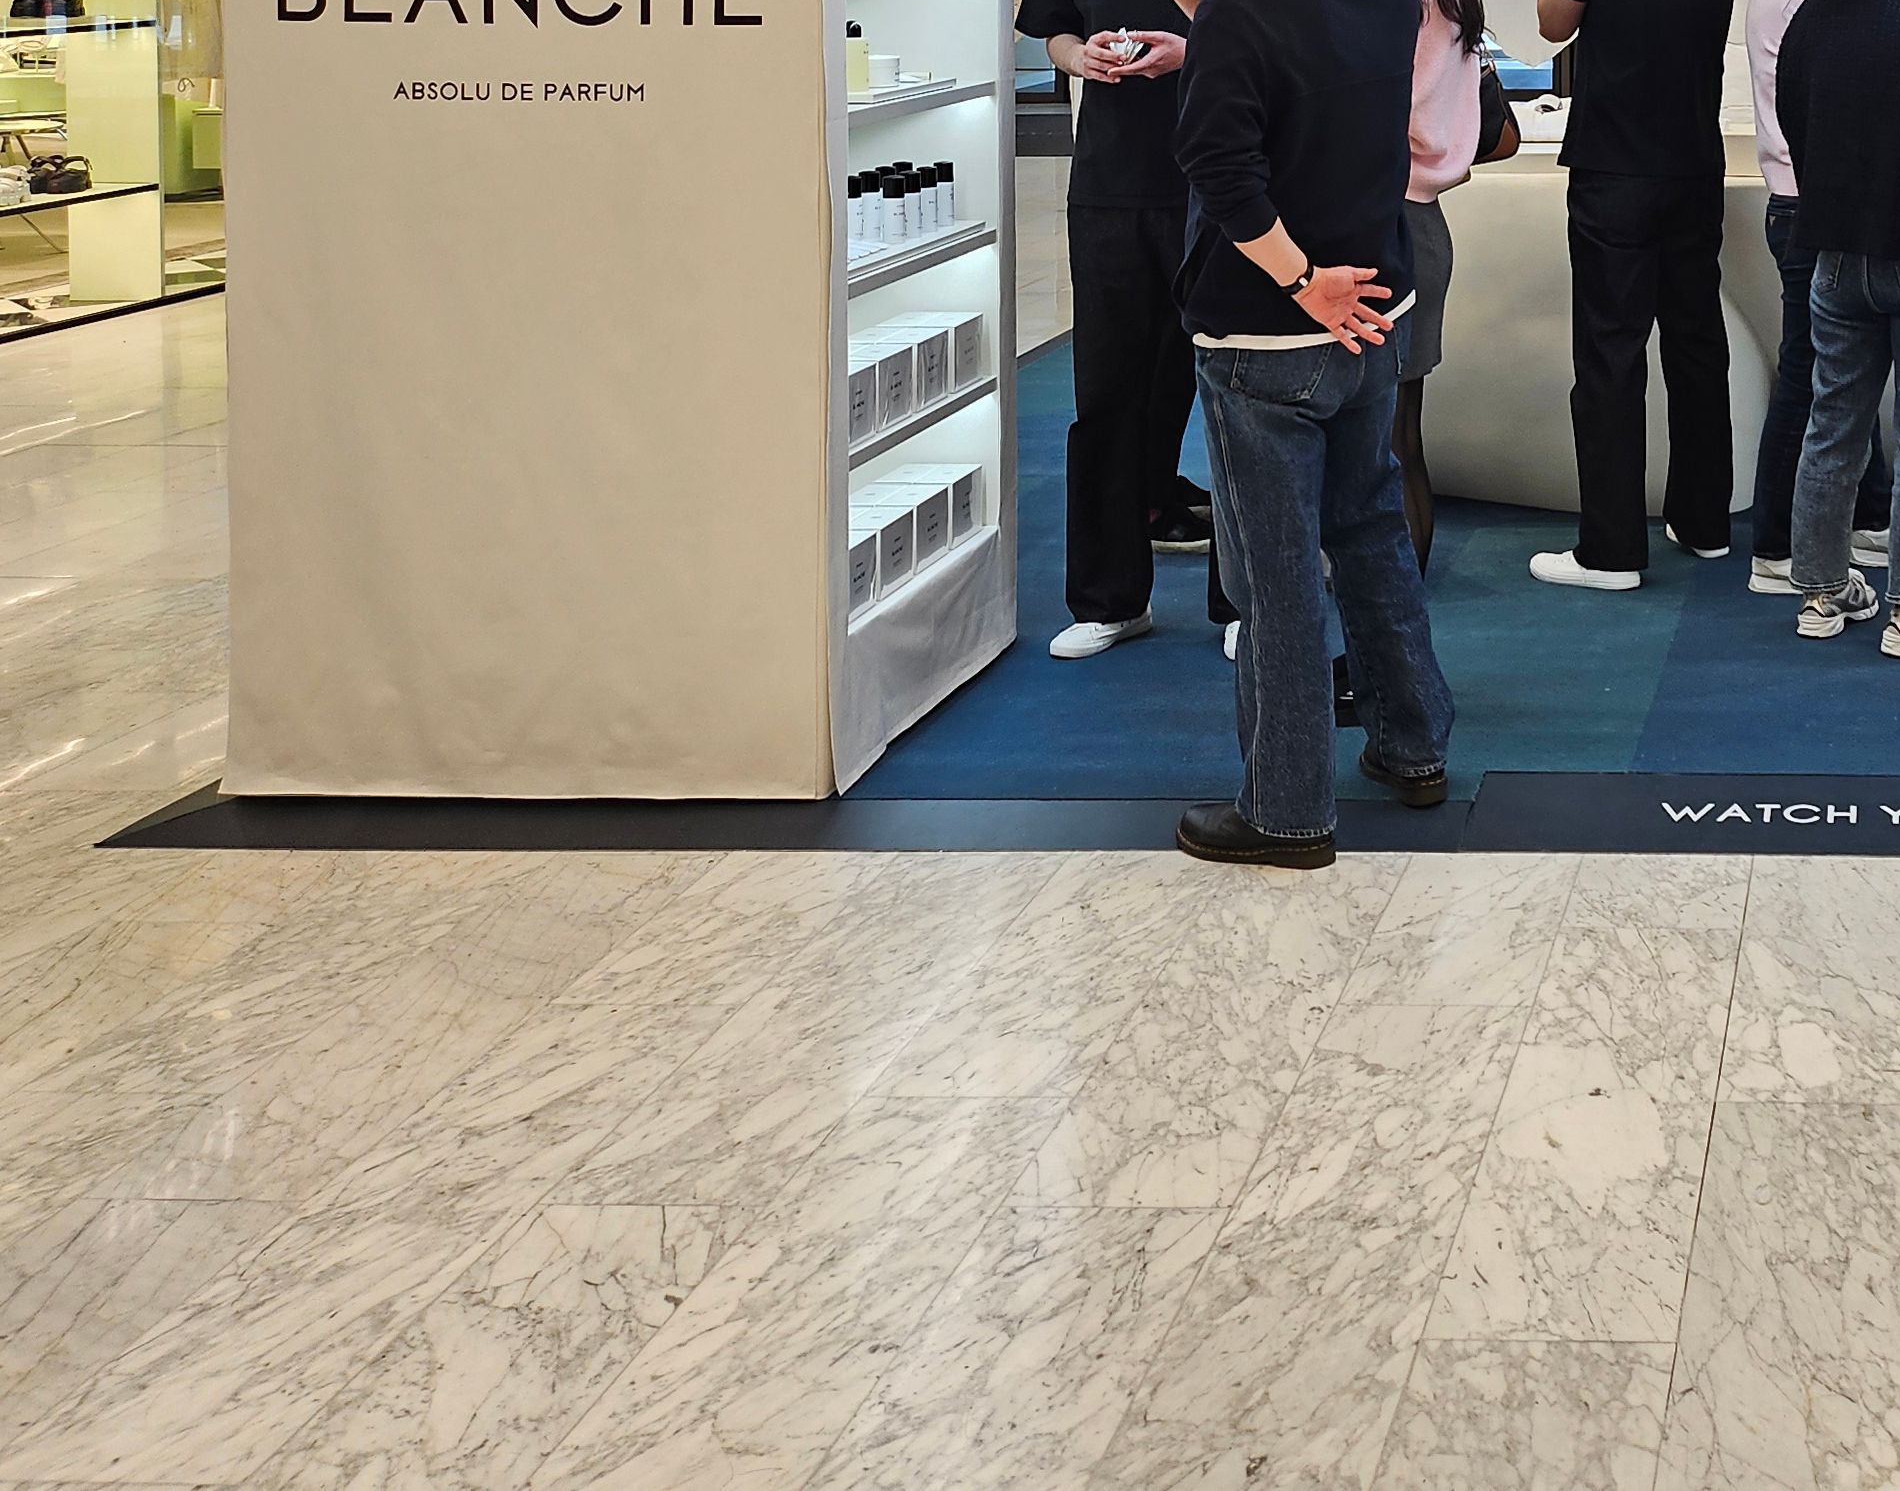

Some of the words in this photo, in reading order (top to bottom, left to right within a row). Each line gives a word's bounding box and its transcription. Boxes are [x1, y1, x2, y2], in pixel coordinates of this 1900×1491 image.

[393, 81, 490, 101] ABSOLU
[501, 82, 534, 101] DE
[543, 83, 646, 103] PARFUM
[1661, 802, 1858, 824] WATCH
